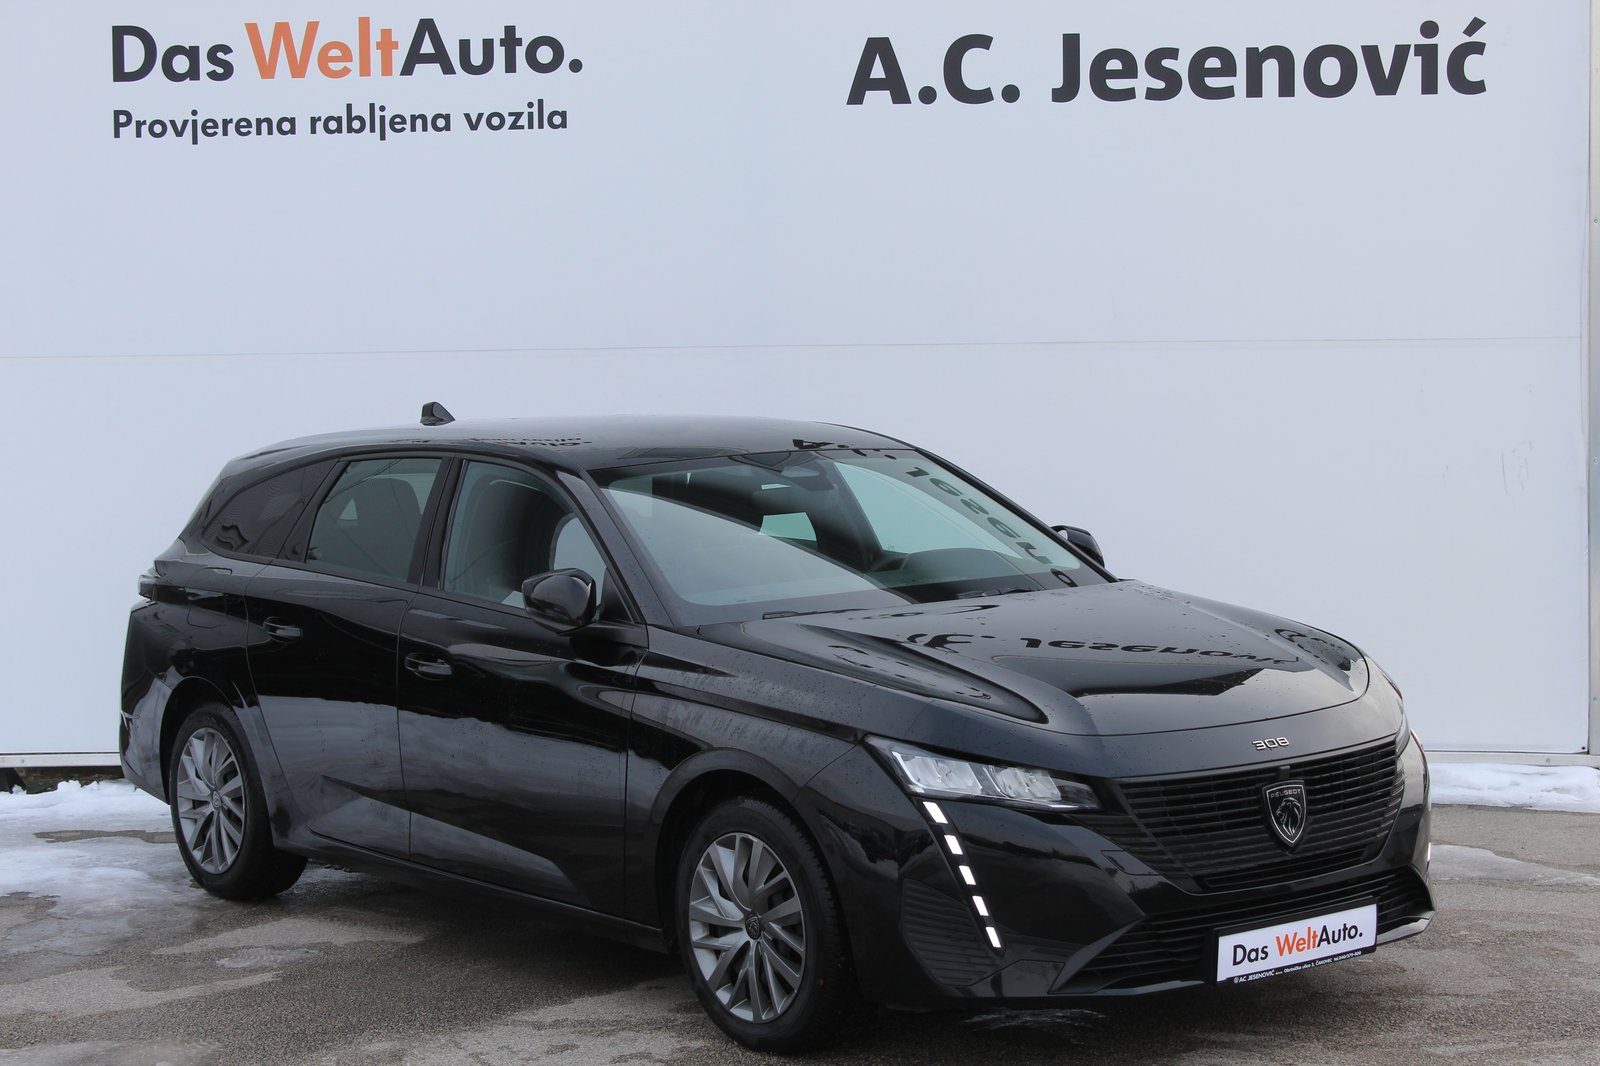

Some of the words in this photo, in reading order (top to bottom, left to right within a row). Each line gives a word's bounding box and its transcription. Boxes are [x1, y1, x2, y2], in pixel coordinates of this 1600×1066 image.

[112, 26, 234, 82] Das
[245, 17, 582, 78] WeltAuto.
[847, 34, 1020, 105] A.C.
[1052, 17, 1487, 103] Jesenović
[113, 109, 297, 145] Provjerena
[309, 103, 451, 141] rabljena
[463, 99, 567, 131] vozila
[1252, 736, 1290, 750] 308
[1270, 788, 1301, 798] PEUGEOT
[1232, 944, 1269, 966] Das
[1275, 923, 1363, 957] WeltAuto.
